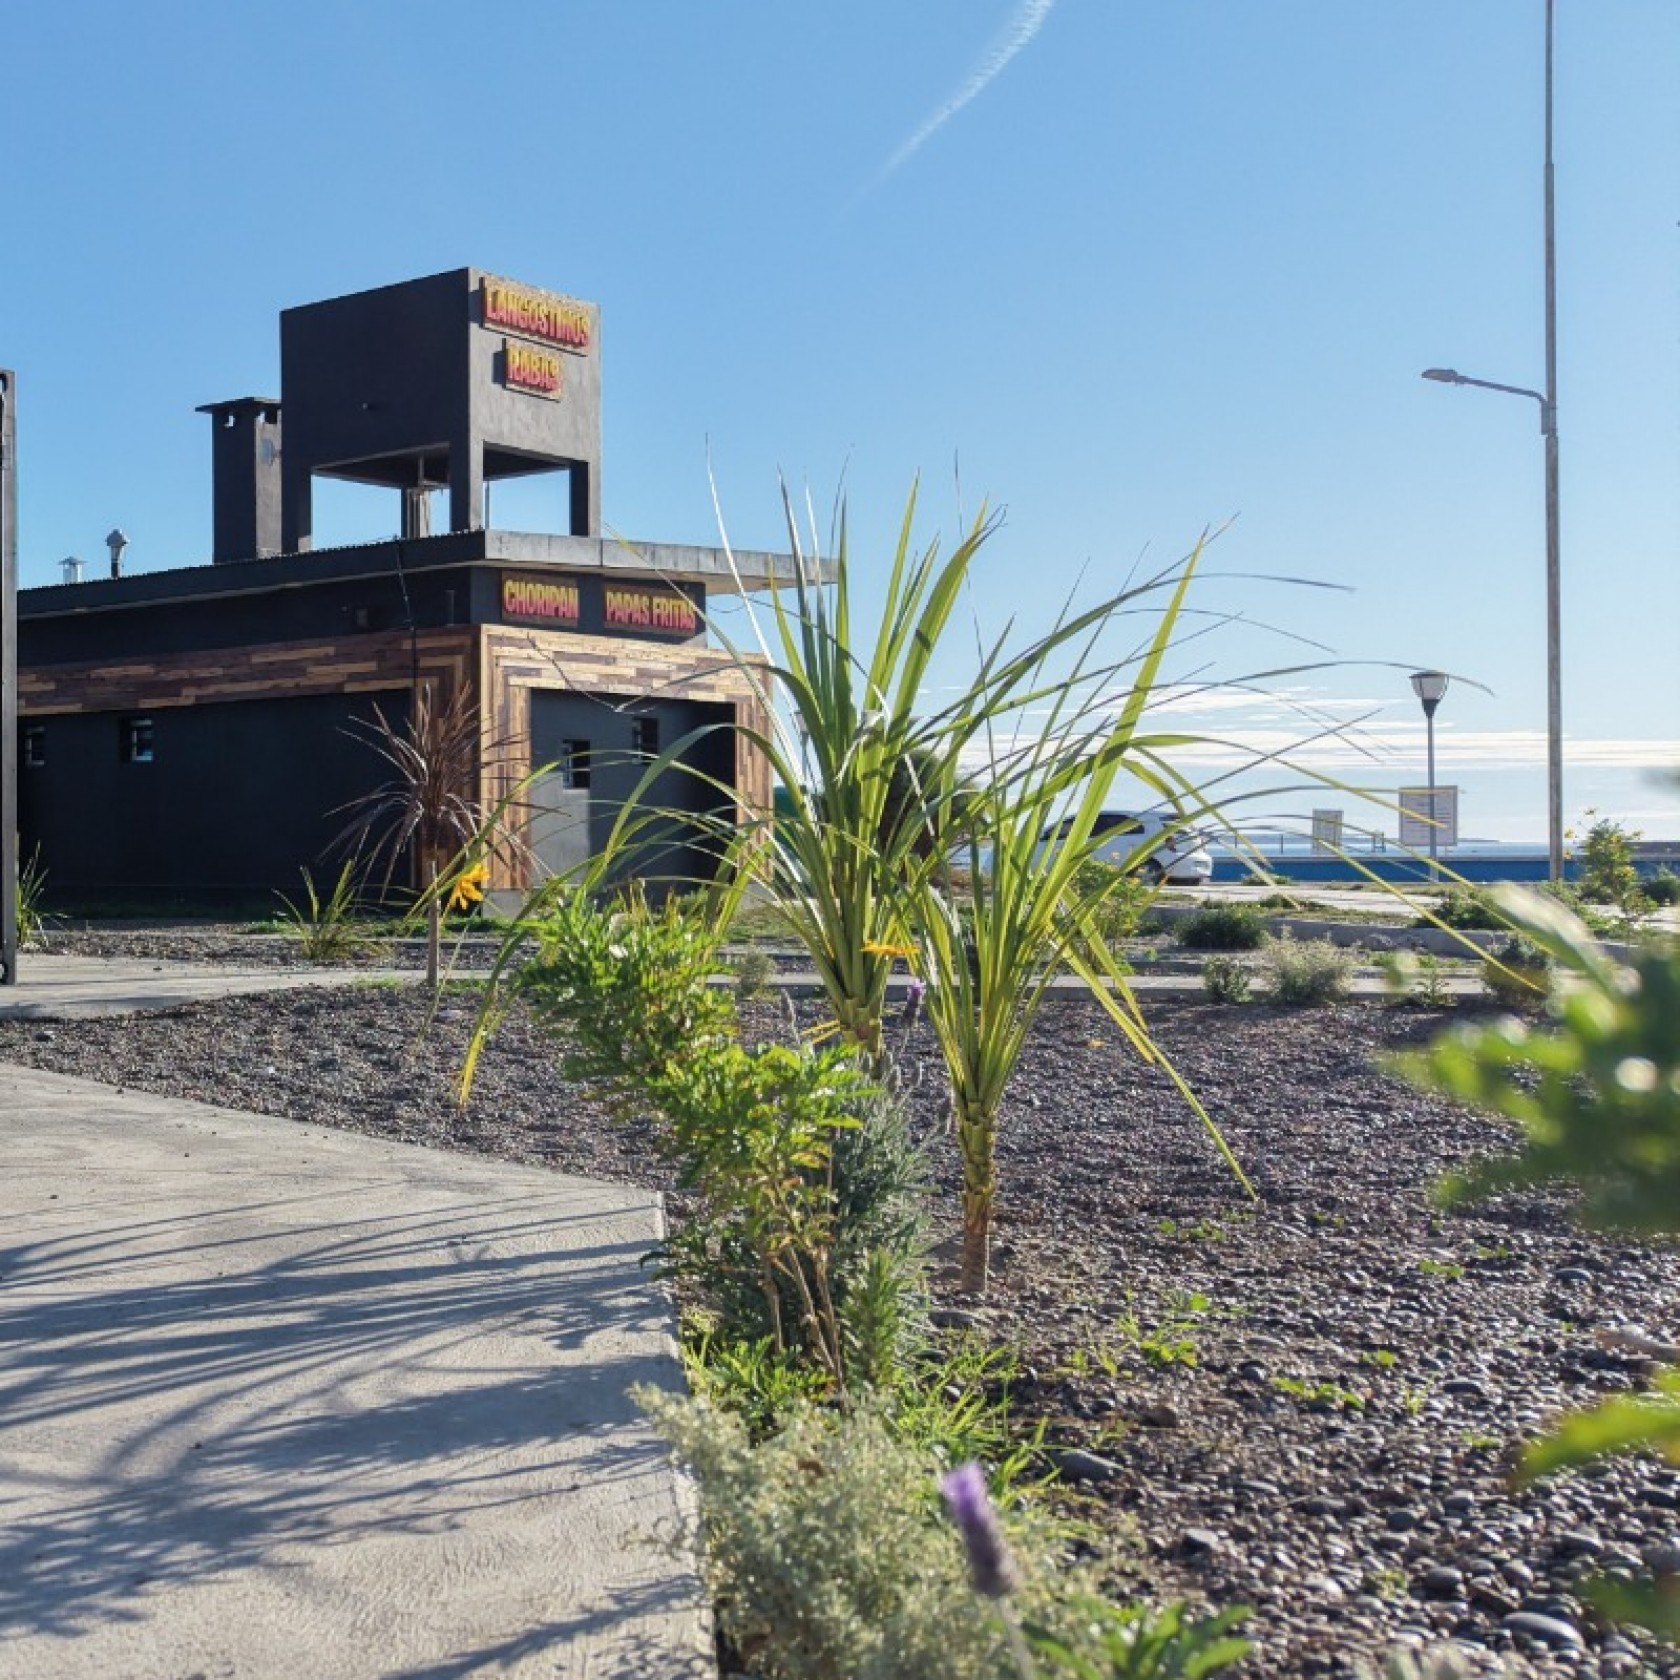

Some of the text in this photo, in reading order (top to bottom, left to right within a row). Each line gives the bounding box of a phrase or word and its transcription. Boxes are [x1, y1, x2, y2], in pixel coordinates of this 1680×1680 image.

[507, 345, 561, 392] RABAS
[503, 578, 579, 619] CHORIPAN
[606, 591, 696, 629] PAPAS FRITAS
